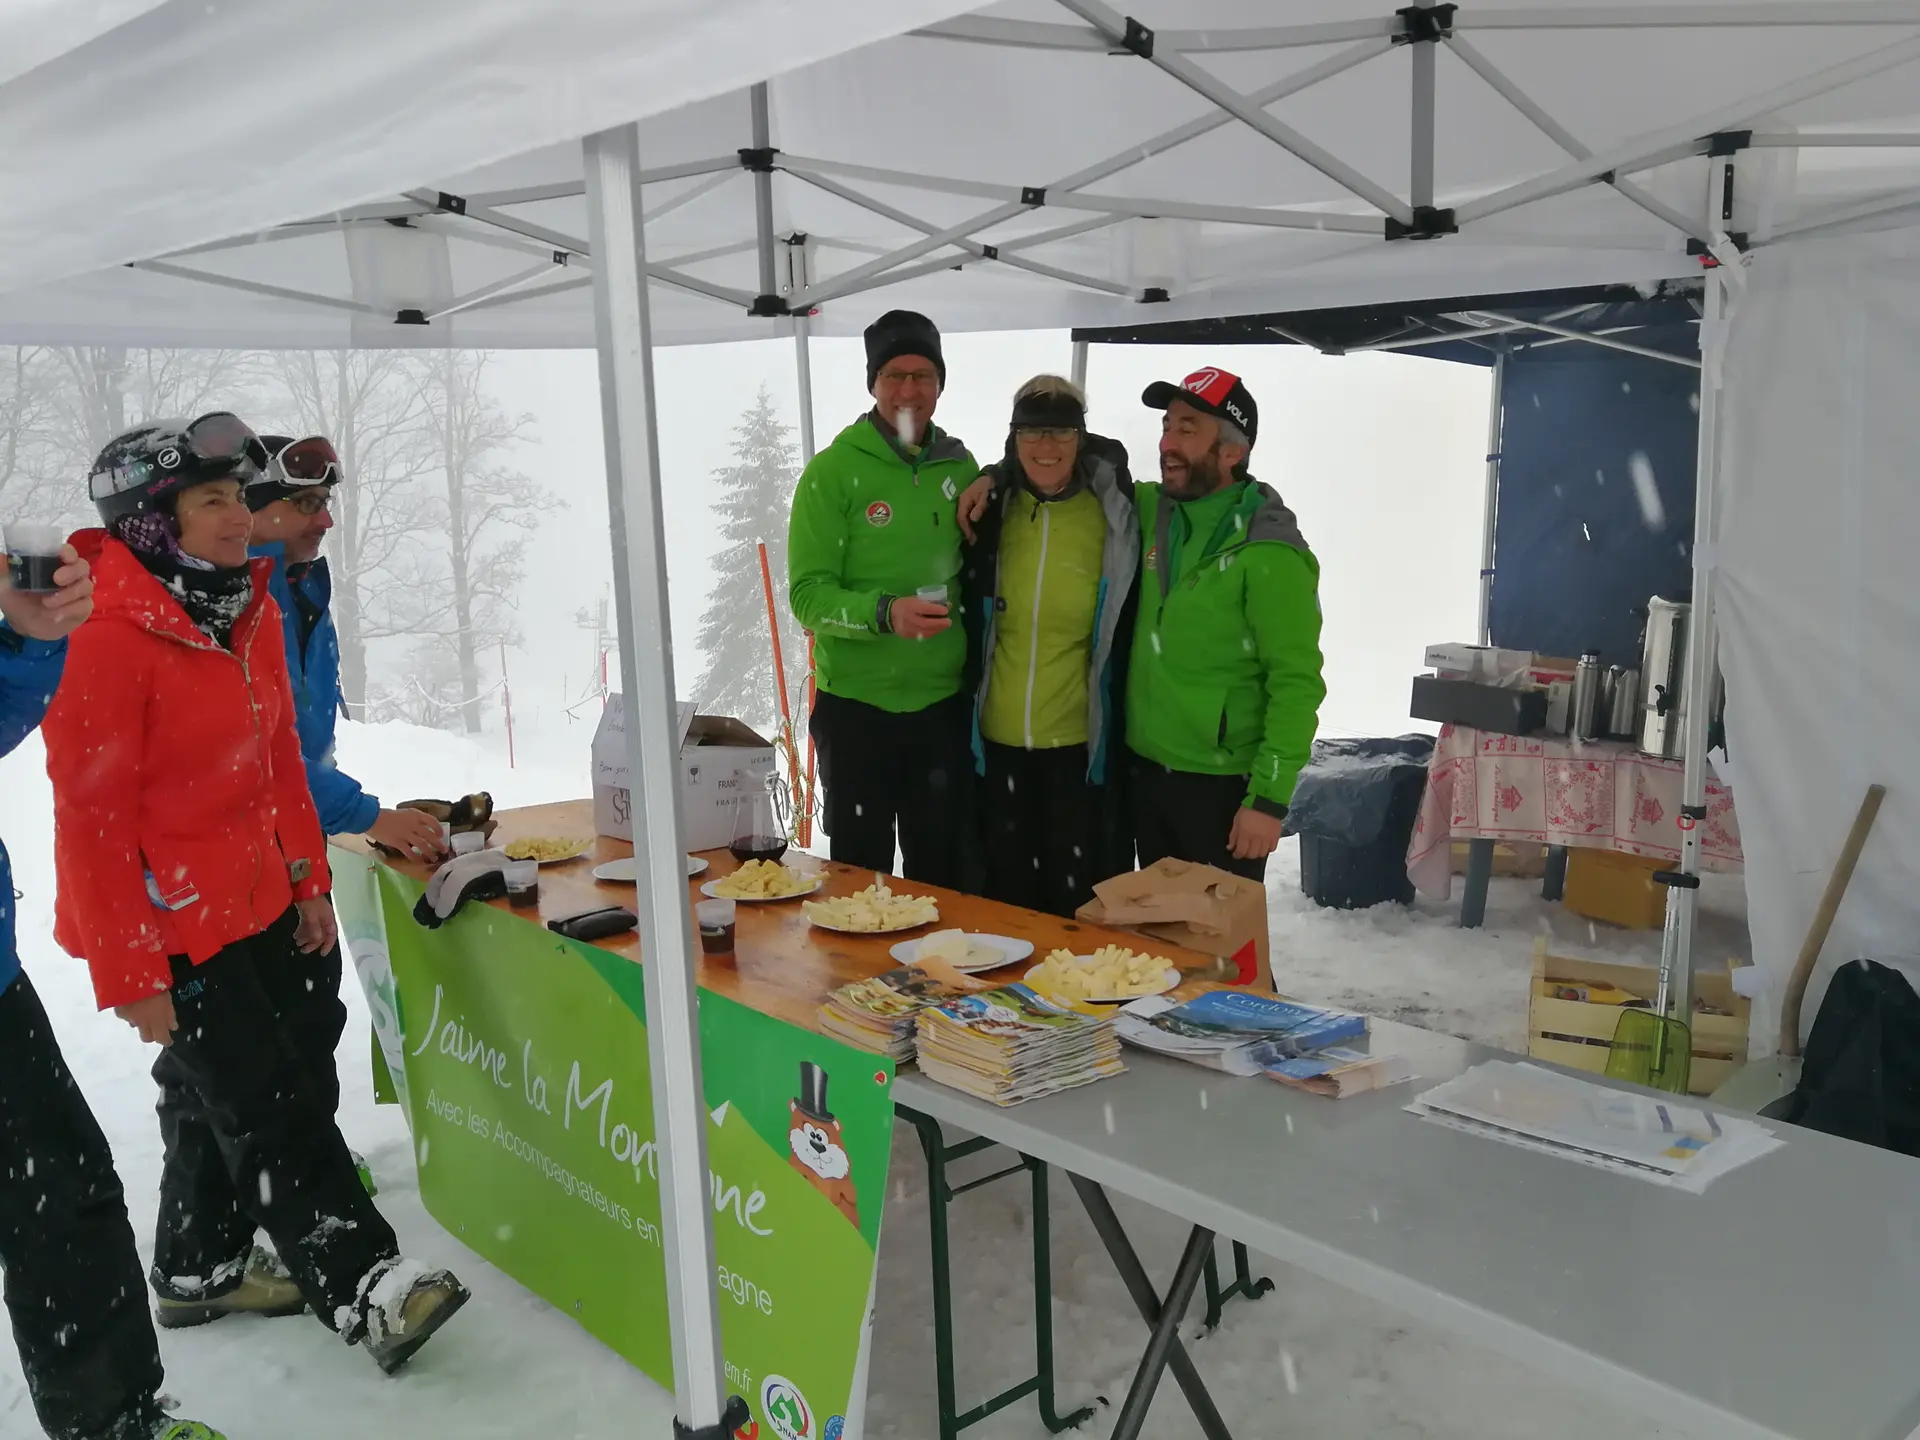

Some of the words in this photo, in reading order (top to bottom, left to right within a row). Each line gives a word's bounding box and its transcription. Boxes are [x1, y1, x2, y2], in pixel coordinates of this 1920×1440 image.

[1226, 400, 1249, 428] VOLA
[1227, 993, 1302, 1016] Cordon
[412, 984, 512, 1088] J'aime
[523, 1038, 552, 1116] la
[426, 1088, 463, 1126] Avec
[467, 1105, 490, 1140] les
[493, 1119, 632, 1229] Accompagnateurs
[636, 1217, 660, 1248] en
